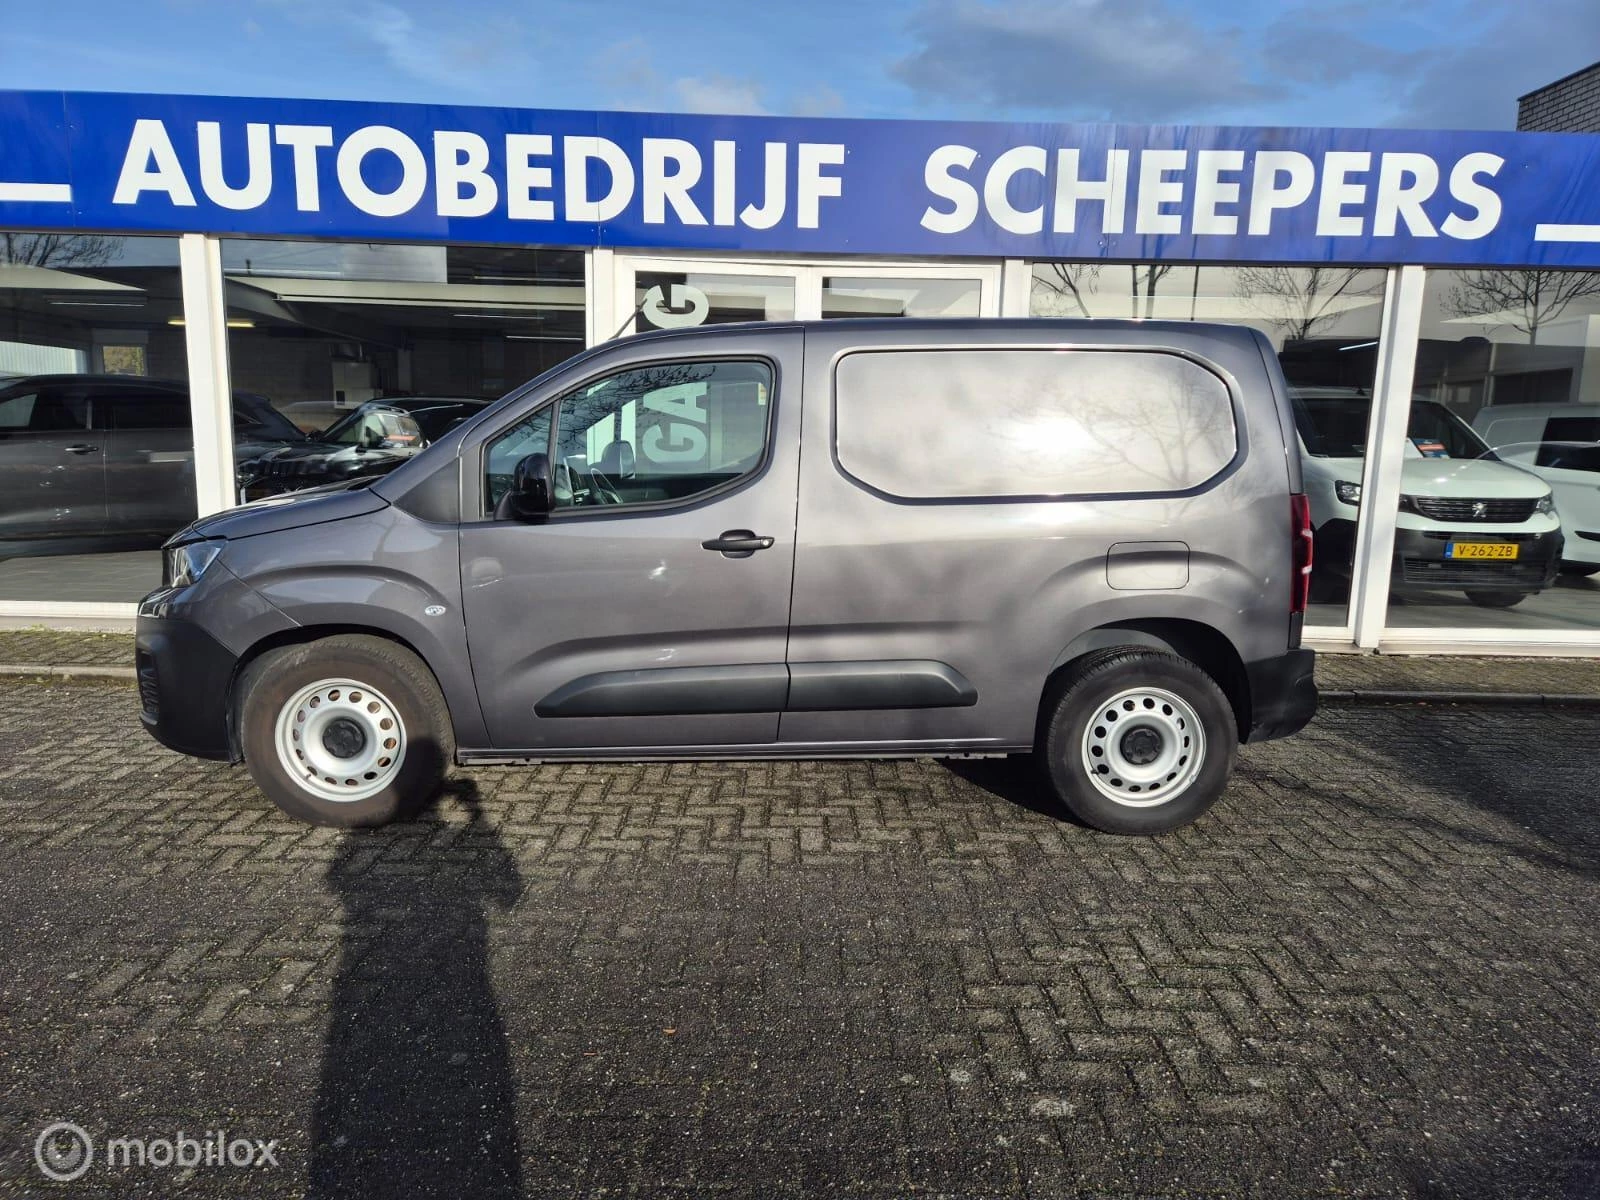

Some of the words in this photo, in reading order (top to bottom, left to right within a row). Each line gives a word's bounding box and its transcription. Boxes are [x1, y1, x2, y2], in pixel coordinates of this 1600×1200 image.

[112, 118, 846, 230] AUTOBEDRIJF
[919, 144, 1506, 240] SCHEEPERS
[1458, 545, 1513, 557] V-262-ZB
